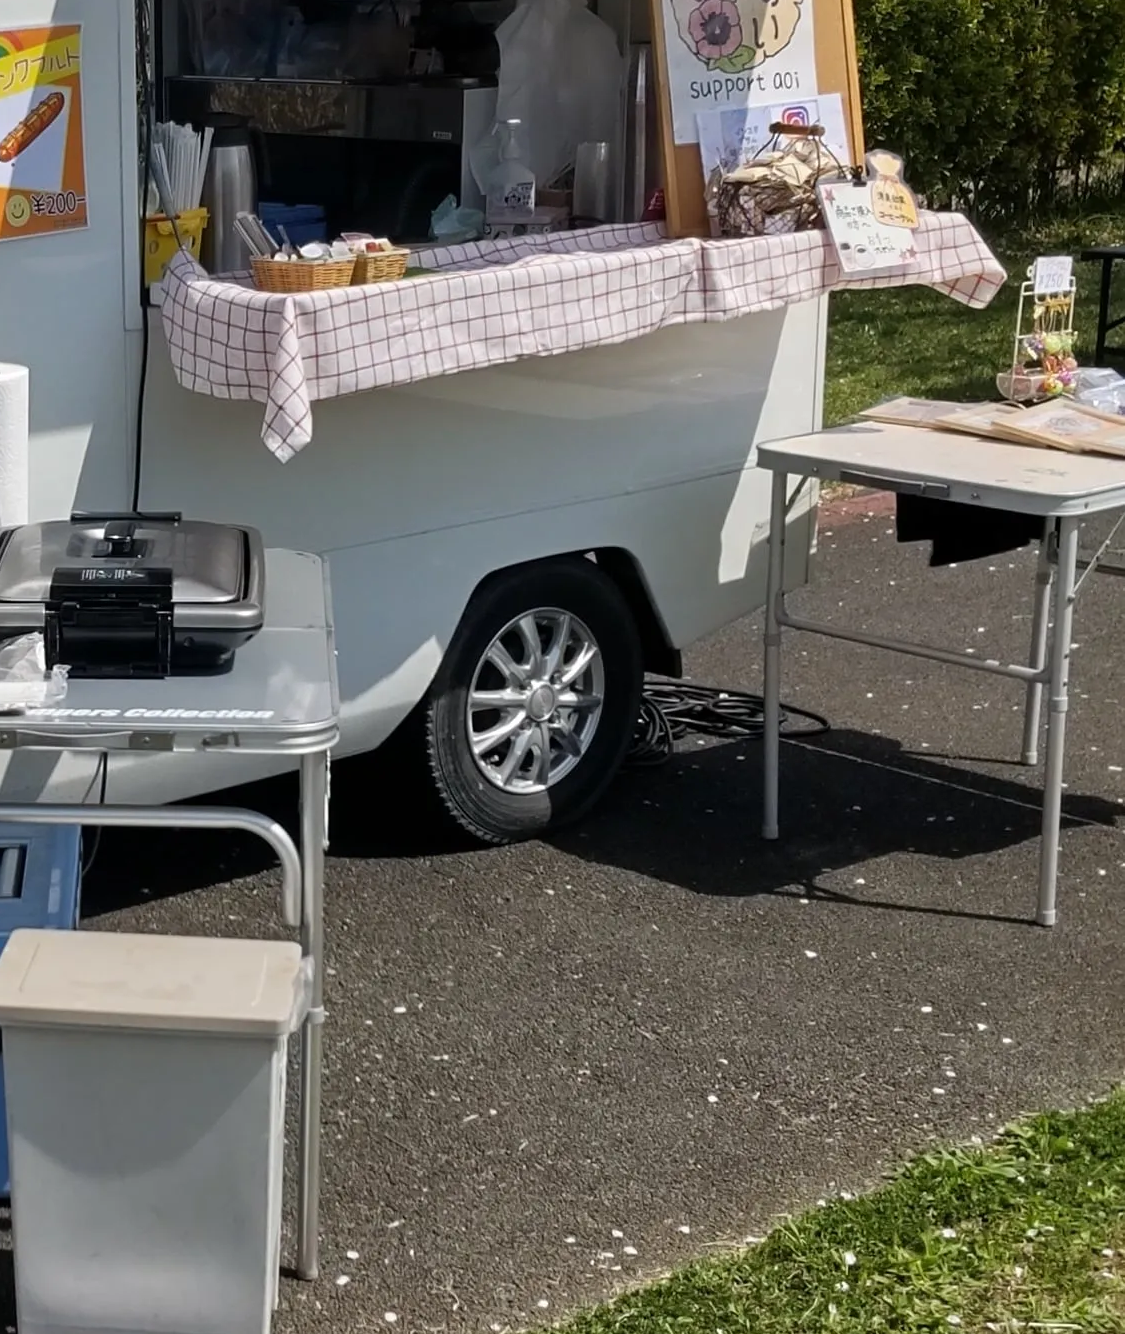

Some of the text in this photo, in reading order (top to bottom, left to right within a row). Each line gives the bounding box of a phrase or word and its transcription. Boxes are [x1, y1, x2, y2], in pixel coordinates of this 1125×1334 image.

[690, 72, 800, 100] support aoi
[124, 708, 275, 717] Collection
